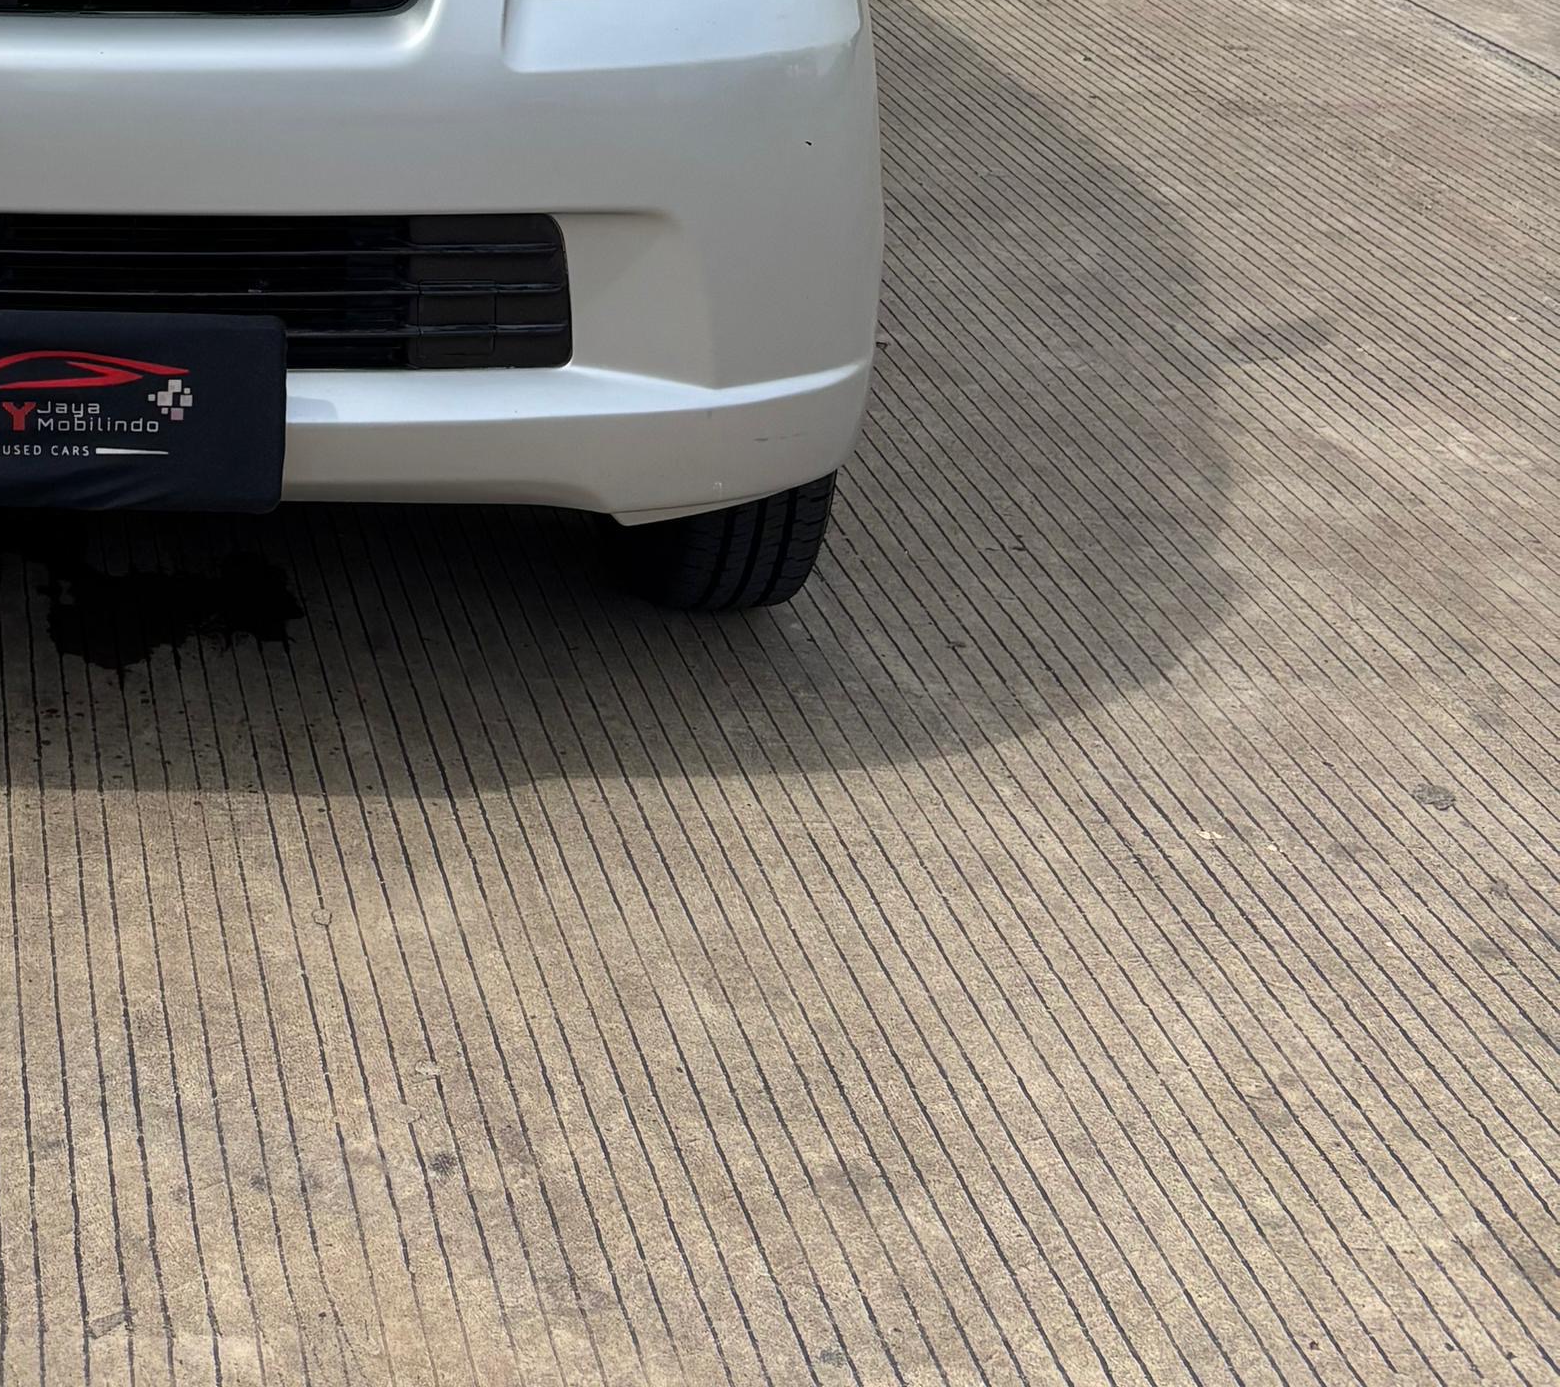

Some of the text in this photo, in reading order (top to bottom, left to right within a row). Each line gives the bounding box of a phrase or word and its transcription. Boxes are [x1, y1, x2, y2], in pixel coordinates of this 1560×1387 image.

[37, 401, 101, 418] Jaya
[37, 417, 160, 433] Mobilindo
[2, 444, 42, 456] USED
[50, 445, 90, 457] CARS
